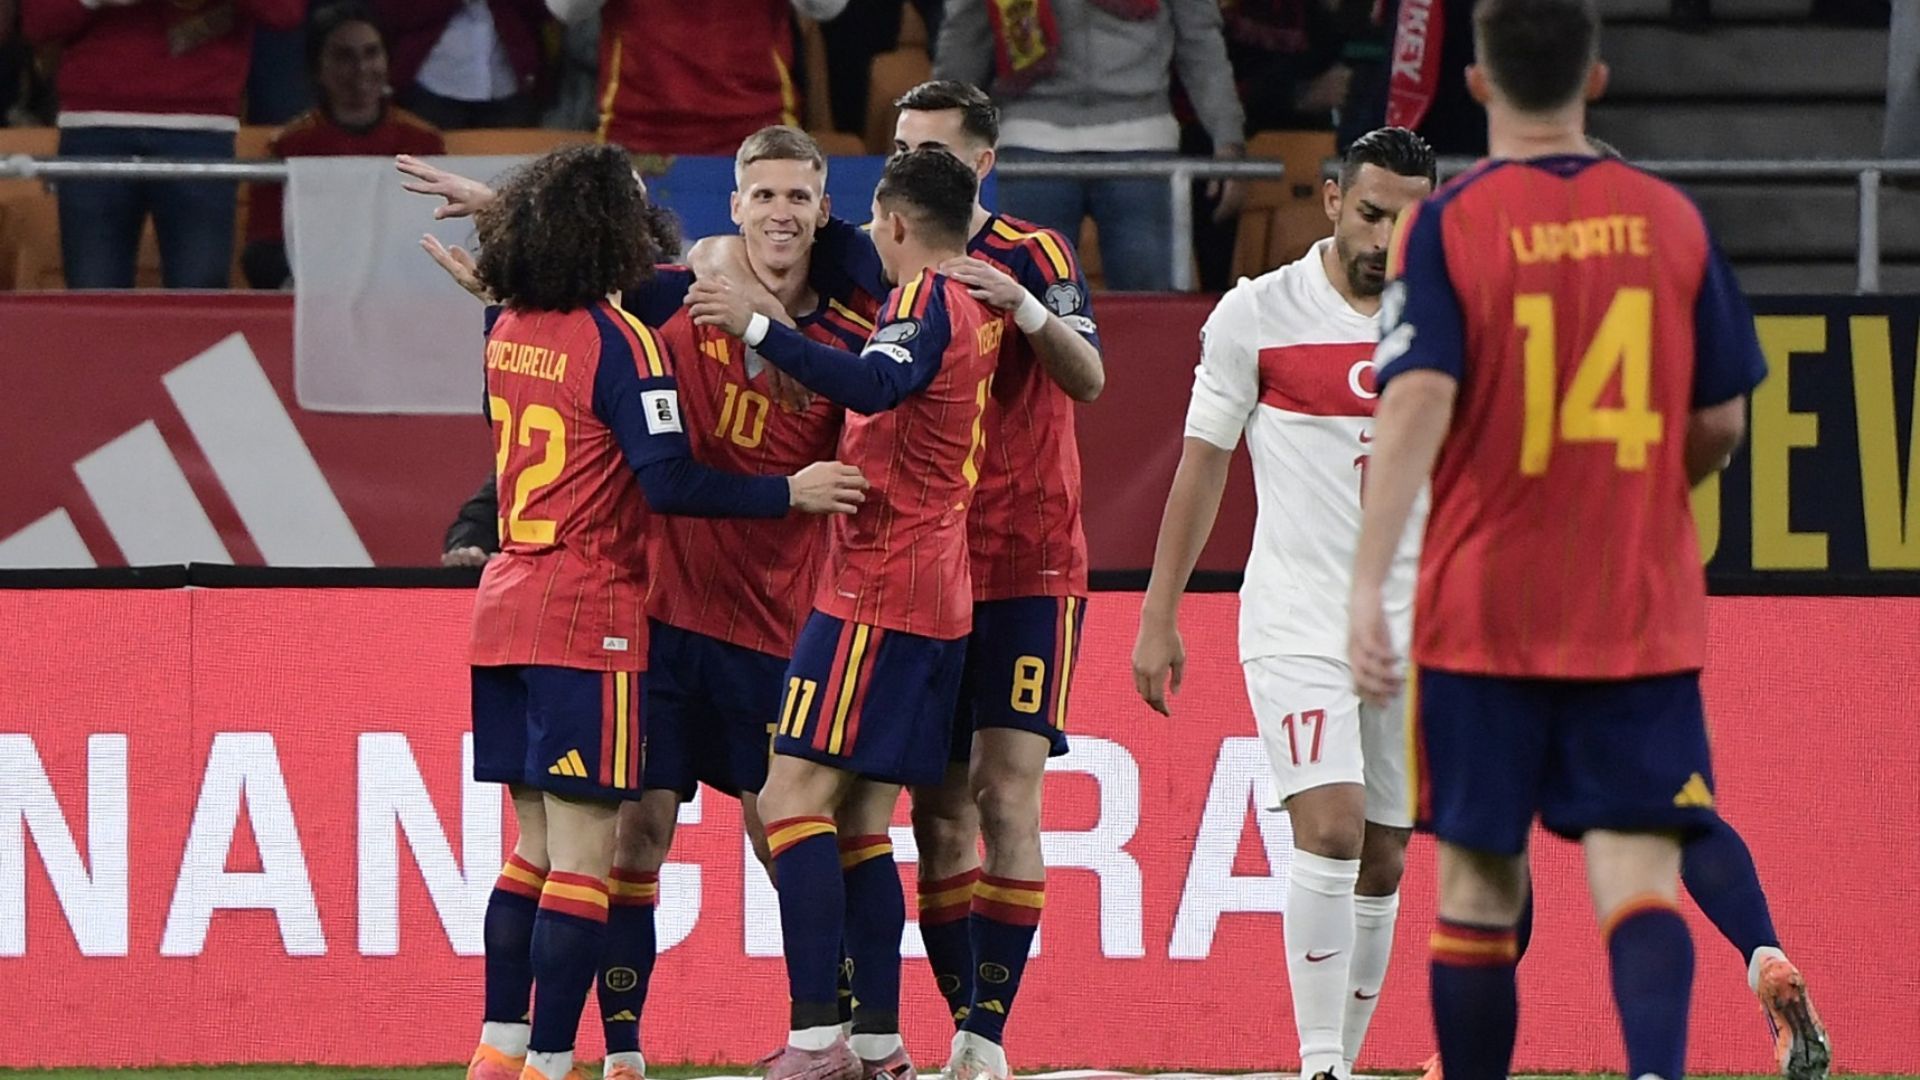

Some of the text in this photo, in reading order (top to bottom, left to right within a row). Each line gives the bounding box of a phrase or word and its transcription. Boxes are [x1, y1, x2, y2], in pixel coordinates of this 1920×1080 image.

[1391, 0, 1431, 84] KEY
[1511, 215, 1650, 264] LAPORTE
[1513, 287, 1664, 476] 14
[713, 382, 770, 448] 10
[962, 372, 994, 490] 1
[1687, 315, 1920, 571] EV
[778, 676, 818, 739] 11
[1010, 655, 1046, 715] 8
[1281, 707, 1327, 767] 17
